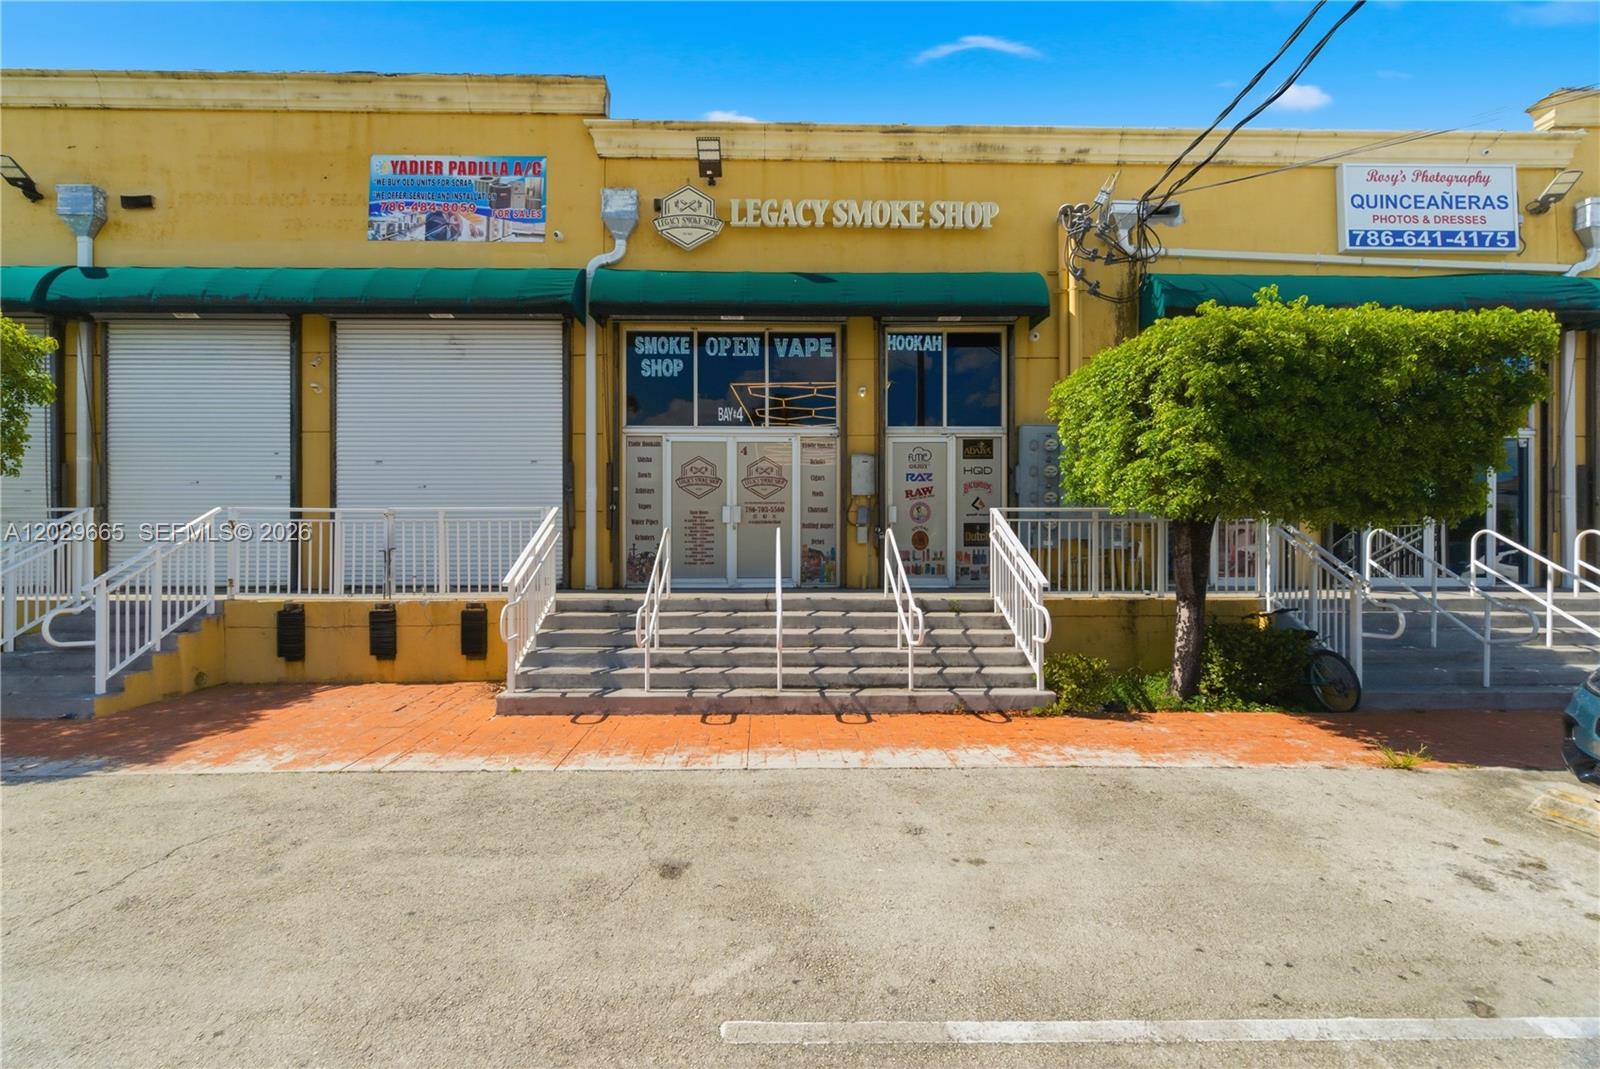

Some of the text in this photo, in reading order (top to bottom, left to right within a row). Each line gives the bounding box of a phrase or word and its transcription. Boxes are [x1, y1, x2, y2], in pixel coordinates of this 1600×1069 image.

[390, 160, 542, 176] YADIER PADILLA A/C
[376, 178, 472, 187] WE BUY OLD UNITS FOR SCRAP
[1366, 169, 1491, 187] Rosy's Photography
[375, 191, 384, 199] WE
[387, 191, 407, 199] OFFER
[409, 191, 434, 199] SERVICE
[1350, 191, 1509, 210] QUINCEAÑERAS
[380, 201, 477, 213] 786-484-8059
[492, 209, 542, 218] FOR SALES
[730, 198, 1000, 229] LEGACY SMOKE SHOP
[1372, 214, 1487, 225] PHOTOS & DRESSES
[1352, 230, 1509, 247] 786-641-4175
[634, 336, 691, 355] SMOKE
[705, 337, 760, 357] OPEN
[774, 337, 833, 358] VAPE
[887, 334, 942, 352] HOOKAH
[640, 358, 684, 377] SHOP
[905, 472, 934, 482] RAZ
[963, 466, 993, 475] HQD
[904, 486, 934, 498] RAW
